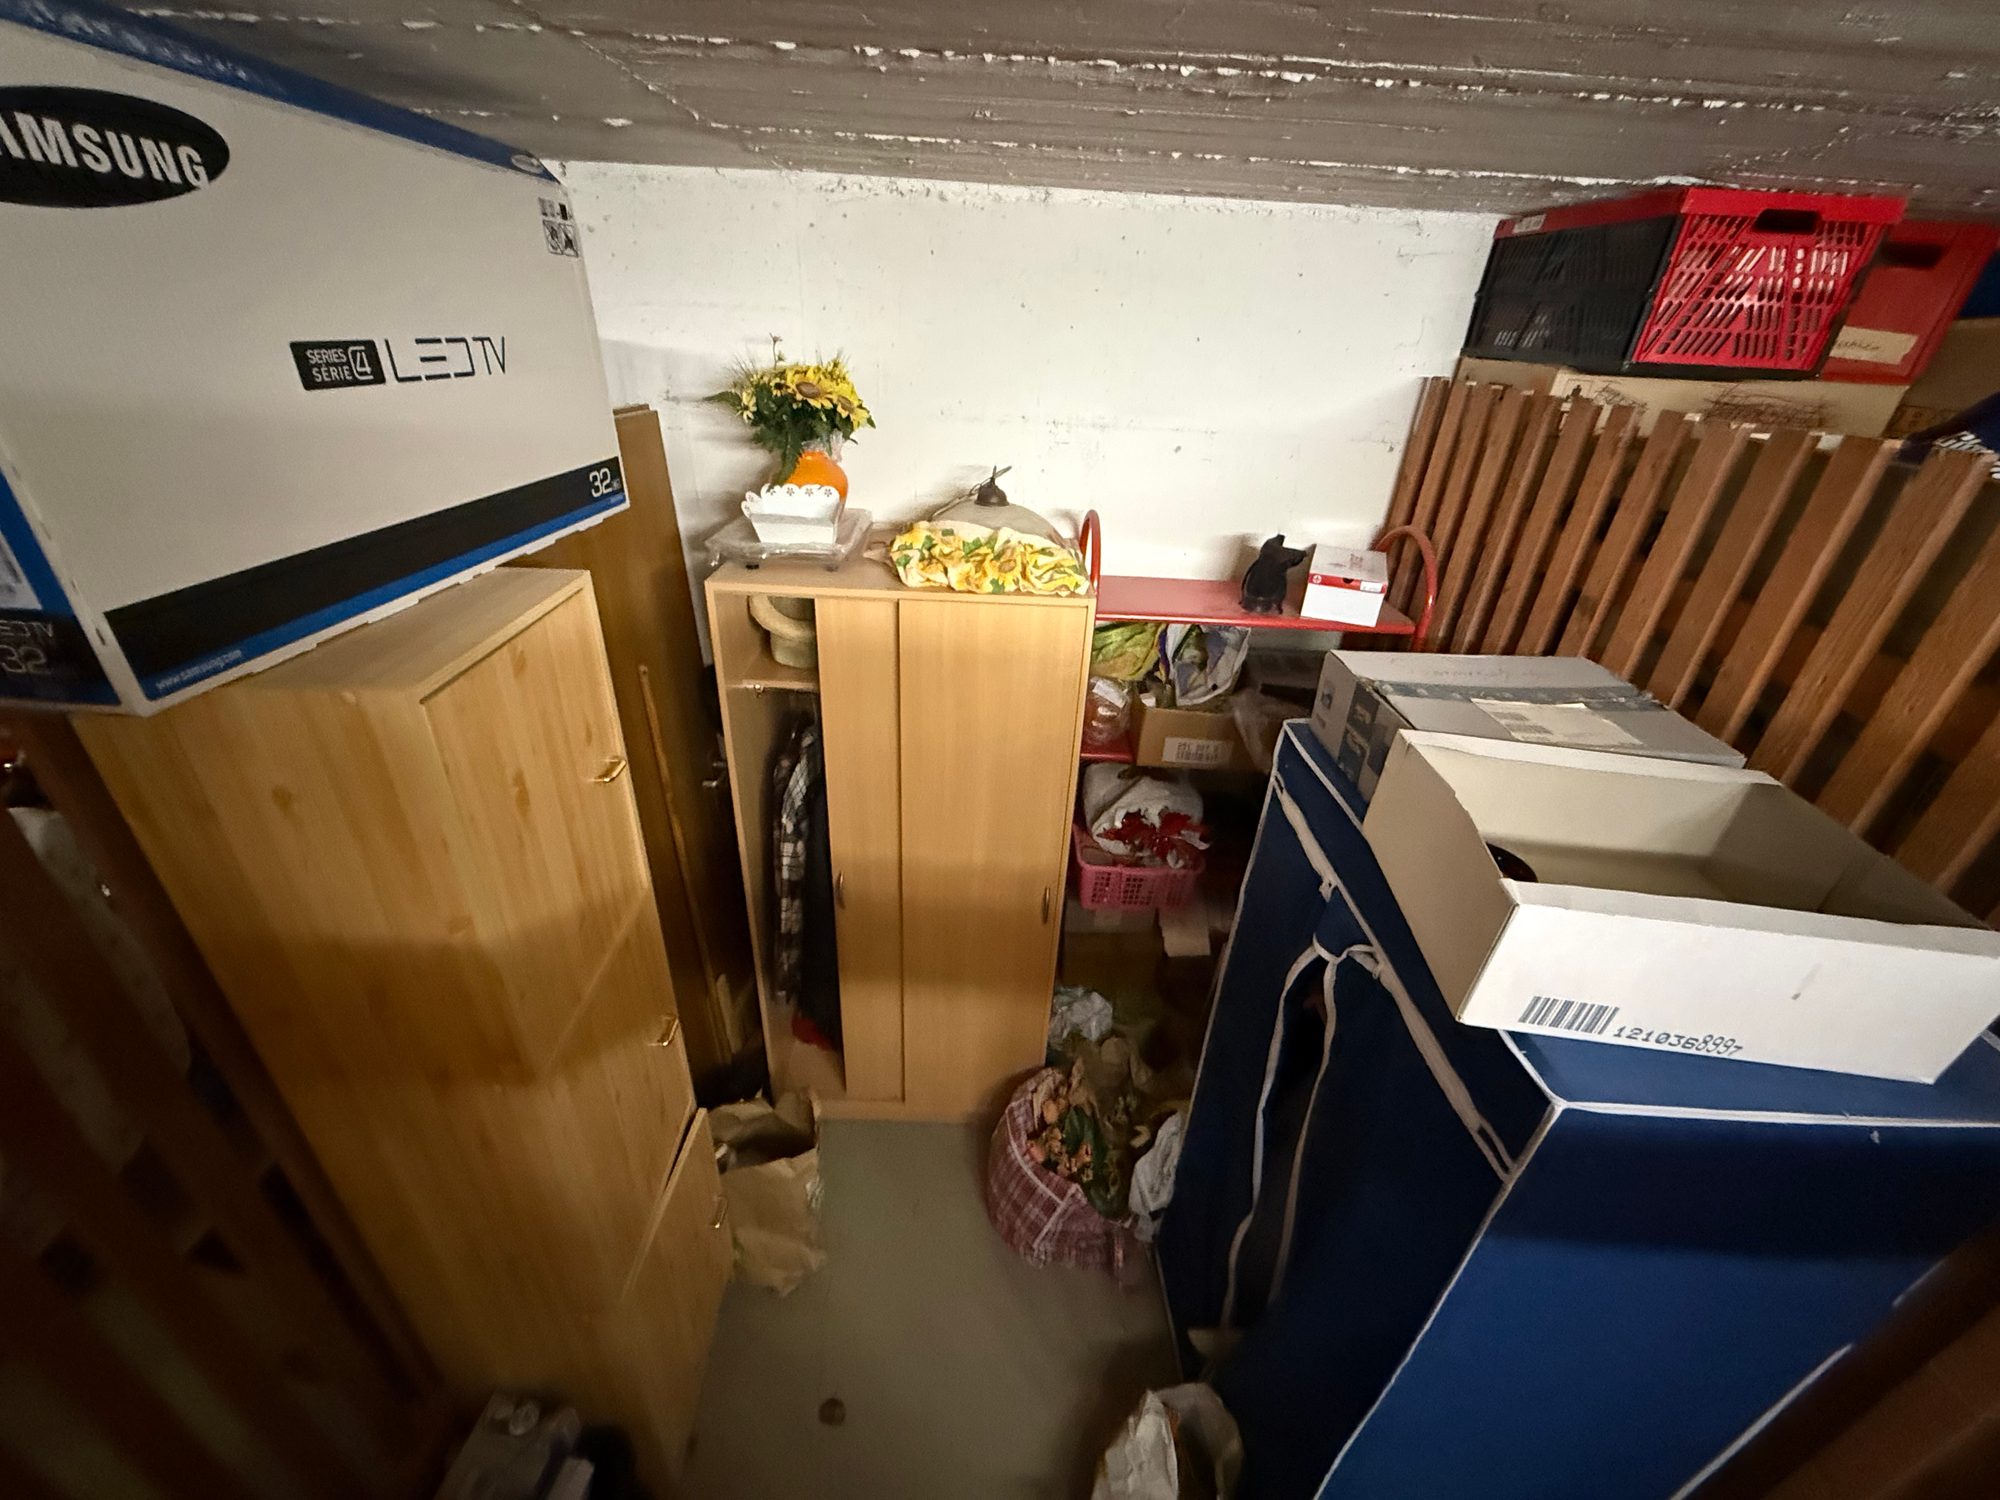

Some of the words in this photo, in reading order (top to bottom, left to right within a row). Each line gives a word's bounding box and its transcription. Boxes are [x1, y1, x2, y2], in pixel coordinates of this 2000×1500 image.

[305, 348, 348, 365] SERIES
[312, 364, 353, 383] SÉRIE
[589, 467, 612, 497] 32
[1612, 1025, 1744, 1056] 1210368997
